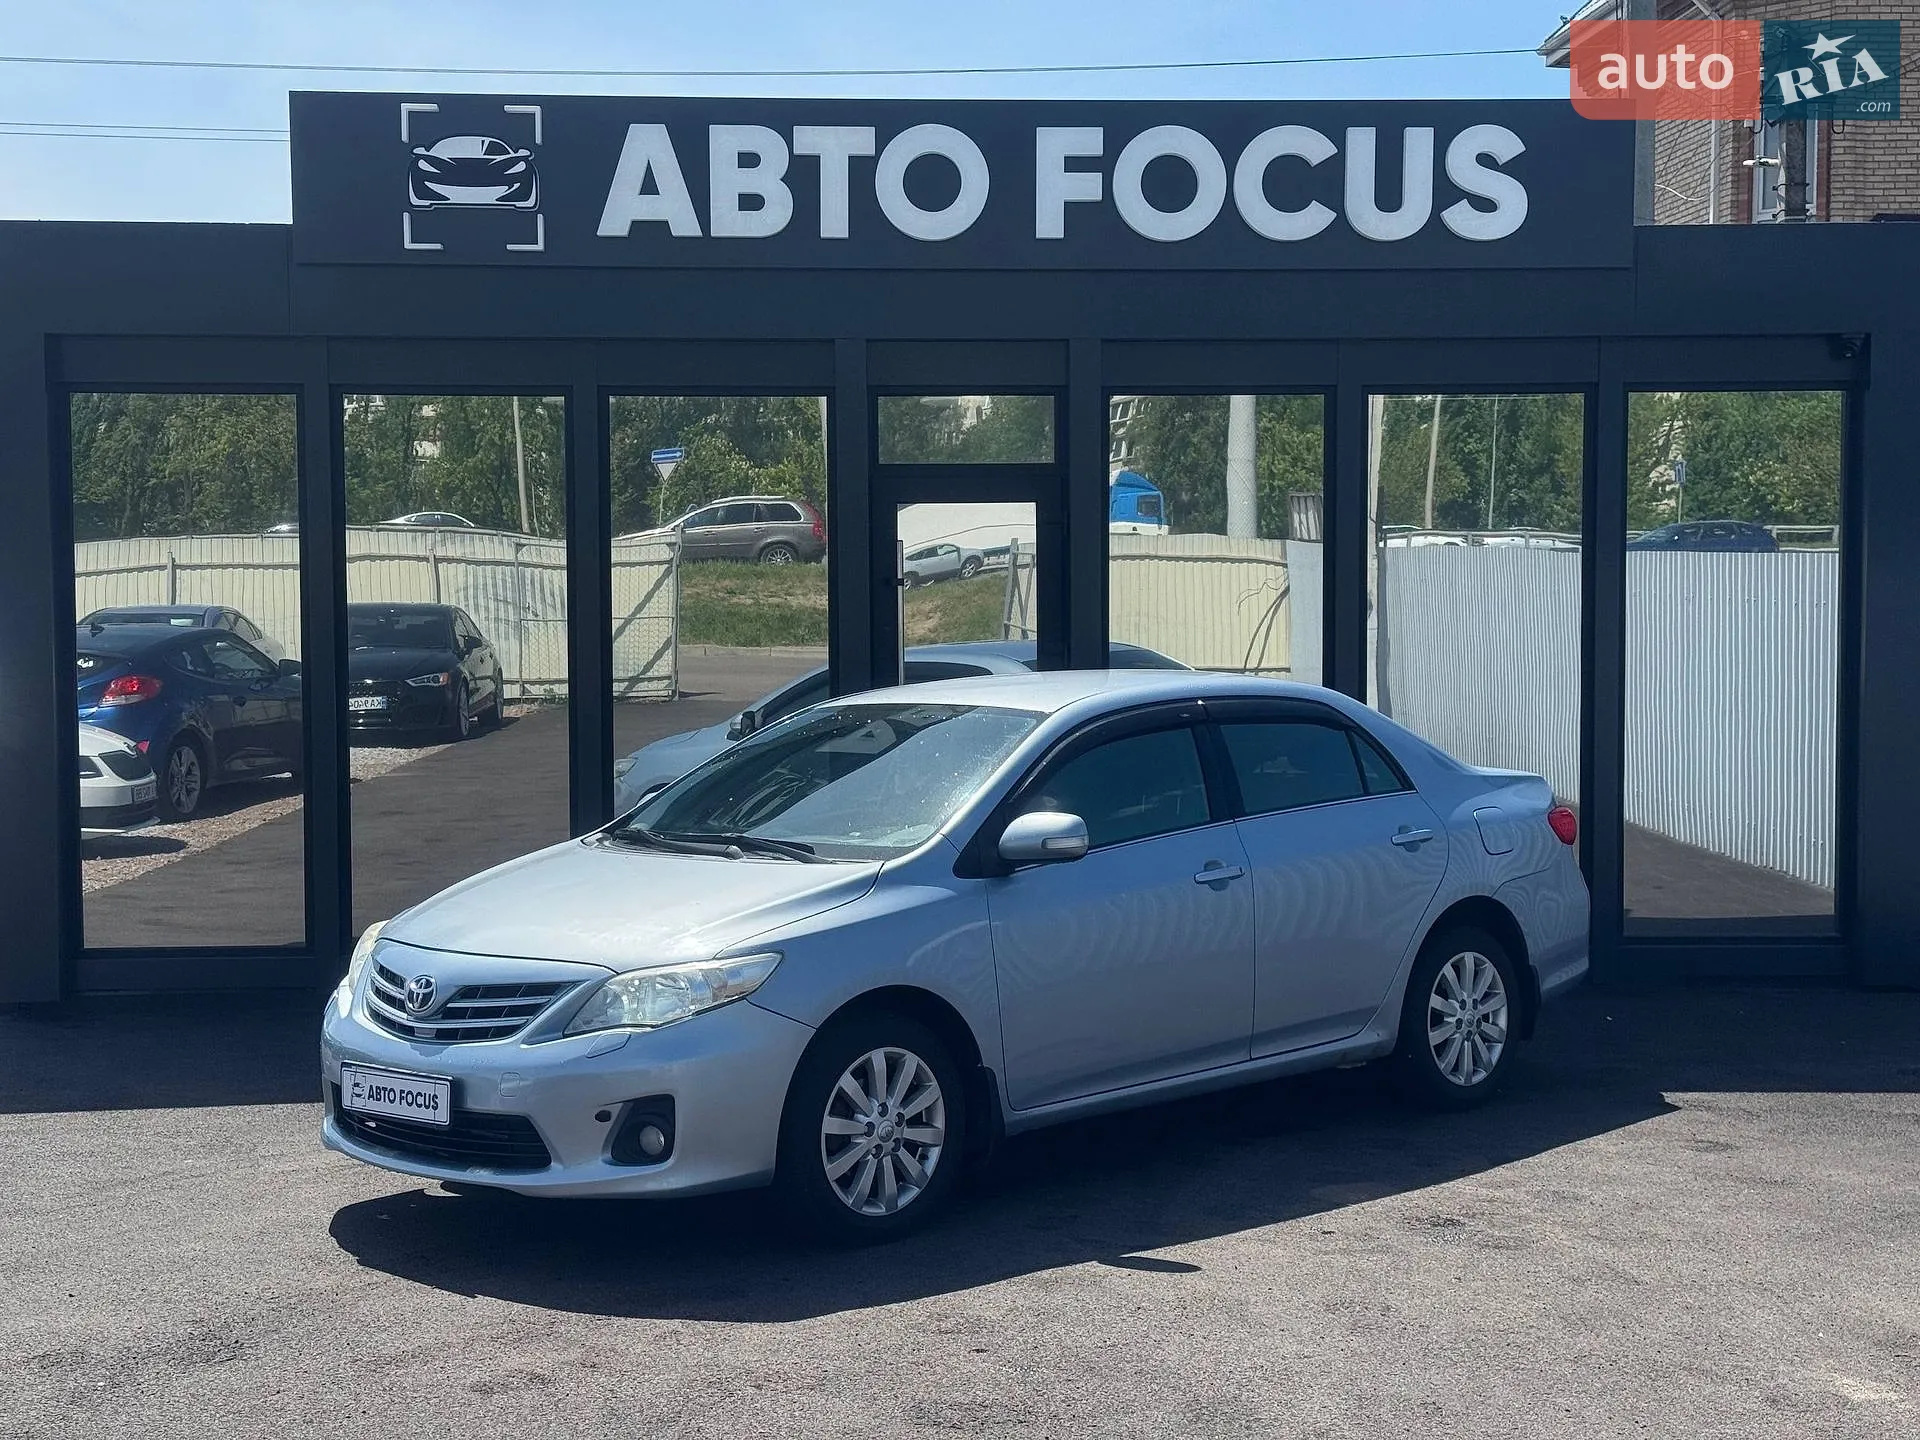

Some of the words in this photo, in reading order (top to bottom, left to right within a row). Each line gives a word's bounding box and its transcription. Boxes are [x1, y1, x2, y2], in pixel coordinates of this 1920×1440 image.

[597, 123, 989, 241] АВТО
[1036, 124, 1528, 242] FOCUS
[367, 1084, 397, 1105] АВТО
[399, 1089, 439, 1111] FOCUS
